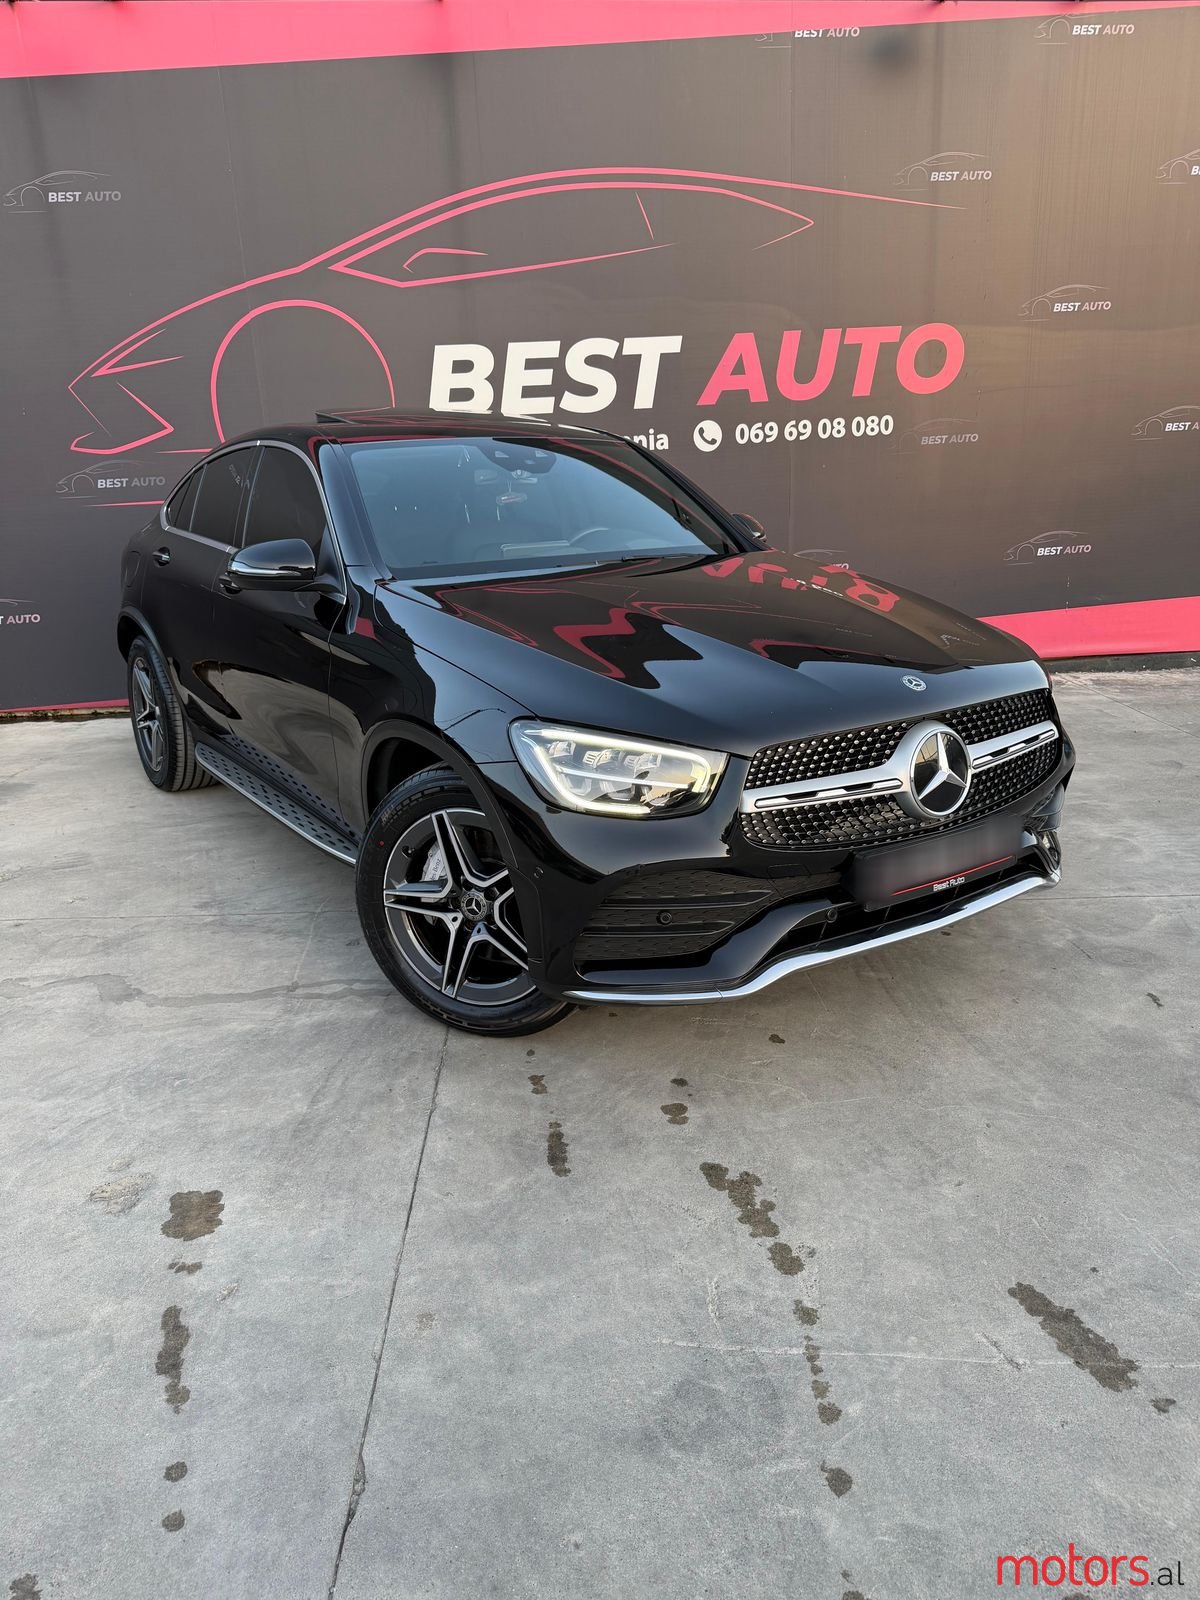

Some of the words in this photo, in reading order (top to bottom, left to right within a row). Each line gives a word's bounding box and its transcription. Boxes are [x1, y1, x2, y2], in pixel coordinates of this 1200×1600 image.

[794, 28, 824, 38] BEST
[826, 26, 860, 38] AUTO
[1072, 24, 1102, 36] BEST
[1102, 24, 1135, 35] AUTO
[930, 171, 960, 182] BEST
[960, 170, 992, 181] AUTO
[48, 191, 82, 203] BEST
[84, 190, 122, 202] AUTO
[1053, 302, 1081, 313] BEST
[1081, 301, 1112, 312] AUTO
[429, 335, 683, 414] BEST
[696, 322, 965, 406] AUTO
[623, 428, 669, 451] nia
[735, 421, 779, 445] 069
[784, 419, 812, 441] 69
[817, 417, 846, 439] 08
[851, 414, 894, 437] 080
[1164, 422, 1192, 432] BEST
[921, 435, 948, 445] BEST
[949, 433, 979, 444] AUTO
[97, 478, 129, 489] BEST
[131, 476, 166, 488] AUTO
[1036, 546, 1063, 557] BEST
[1063, 544, 1092, 555] AUTO
[6, 613, 41, 625] AUTO
[933, 880, 950, 892] Best
[949, 876, 966, 887] Auto
